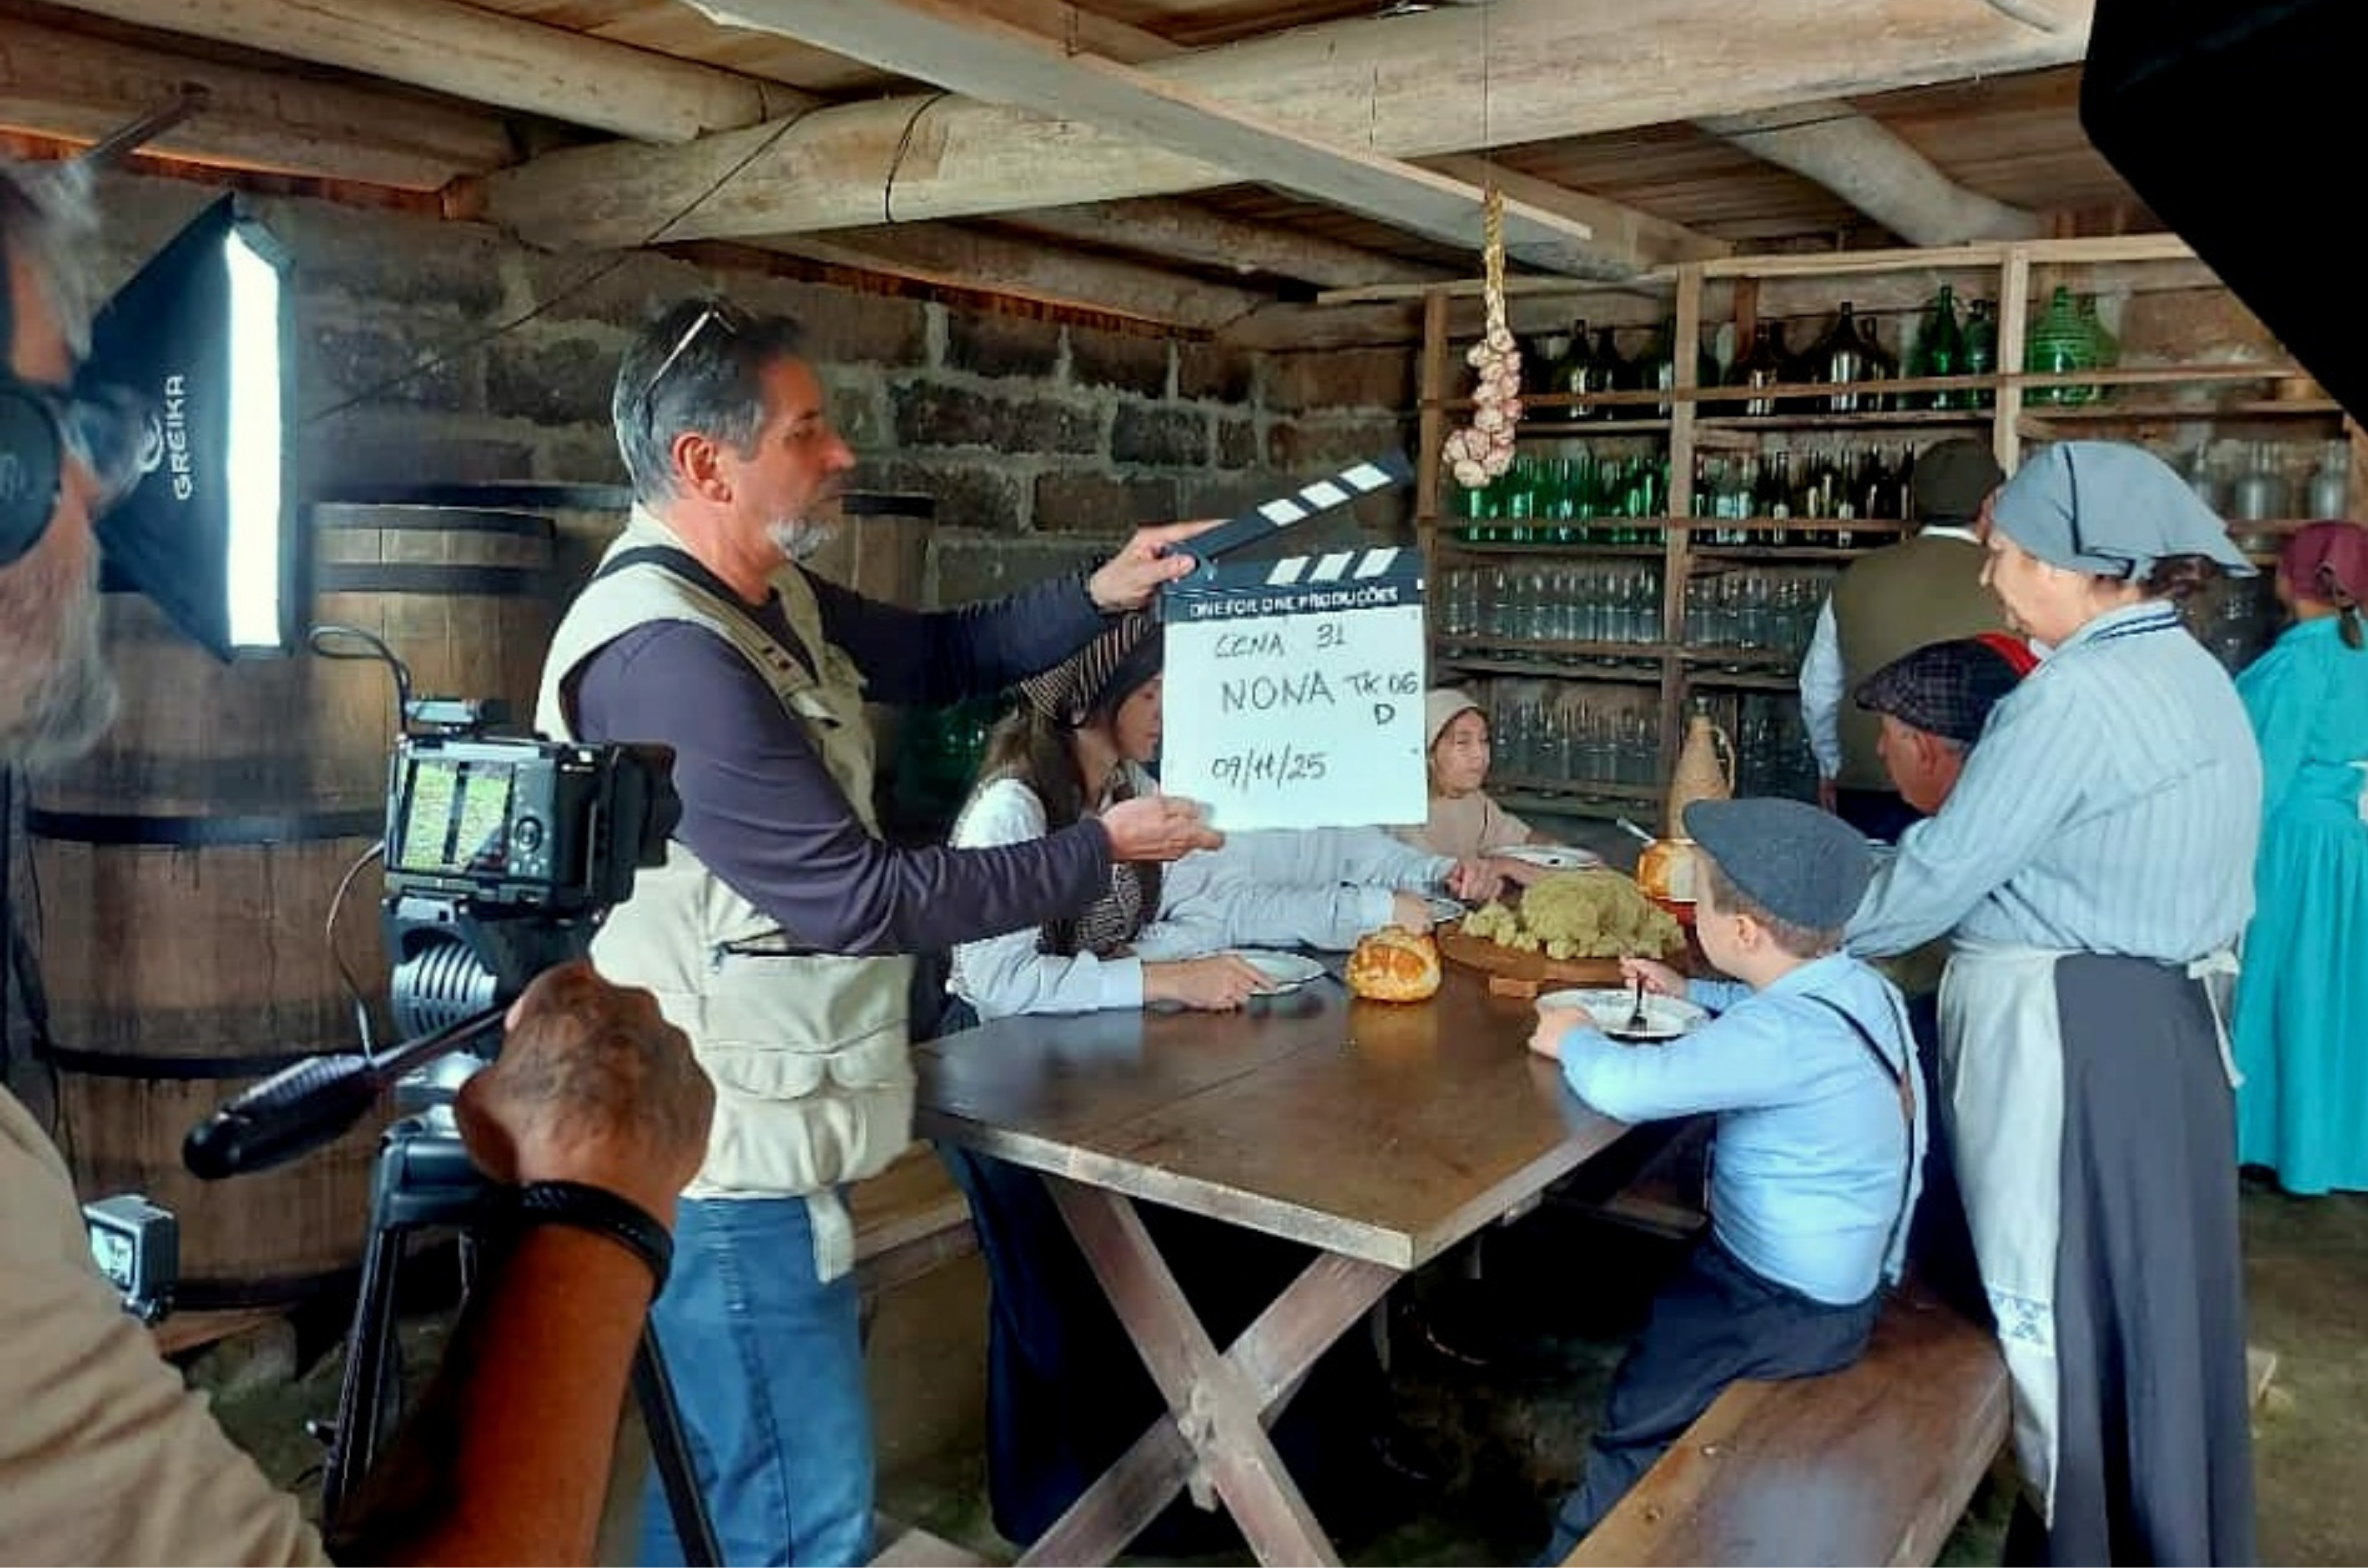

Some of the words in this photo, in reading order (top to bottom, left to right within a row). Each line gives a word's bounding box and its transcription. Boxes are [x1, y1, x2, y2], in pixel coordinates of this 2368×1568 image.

[165, 374, 193, 500] GREIKA
[1215, 632, 1285, 658] CENA
[1316, 623, 1348, 648] 31
[1221, 669, 1336, 714] NONA
[1343, 669, 1381, 697] TK
[1374, 703, 1396, 726] D
